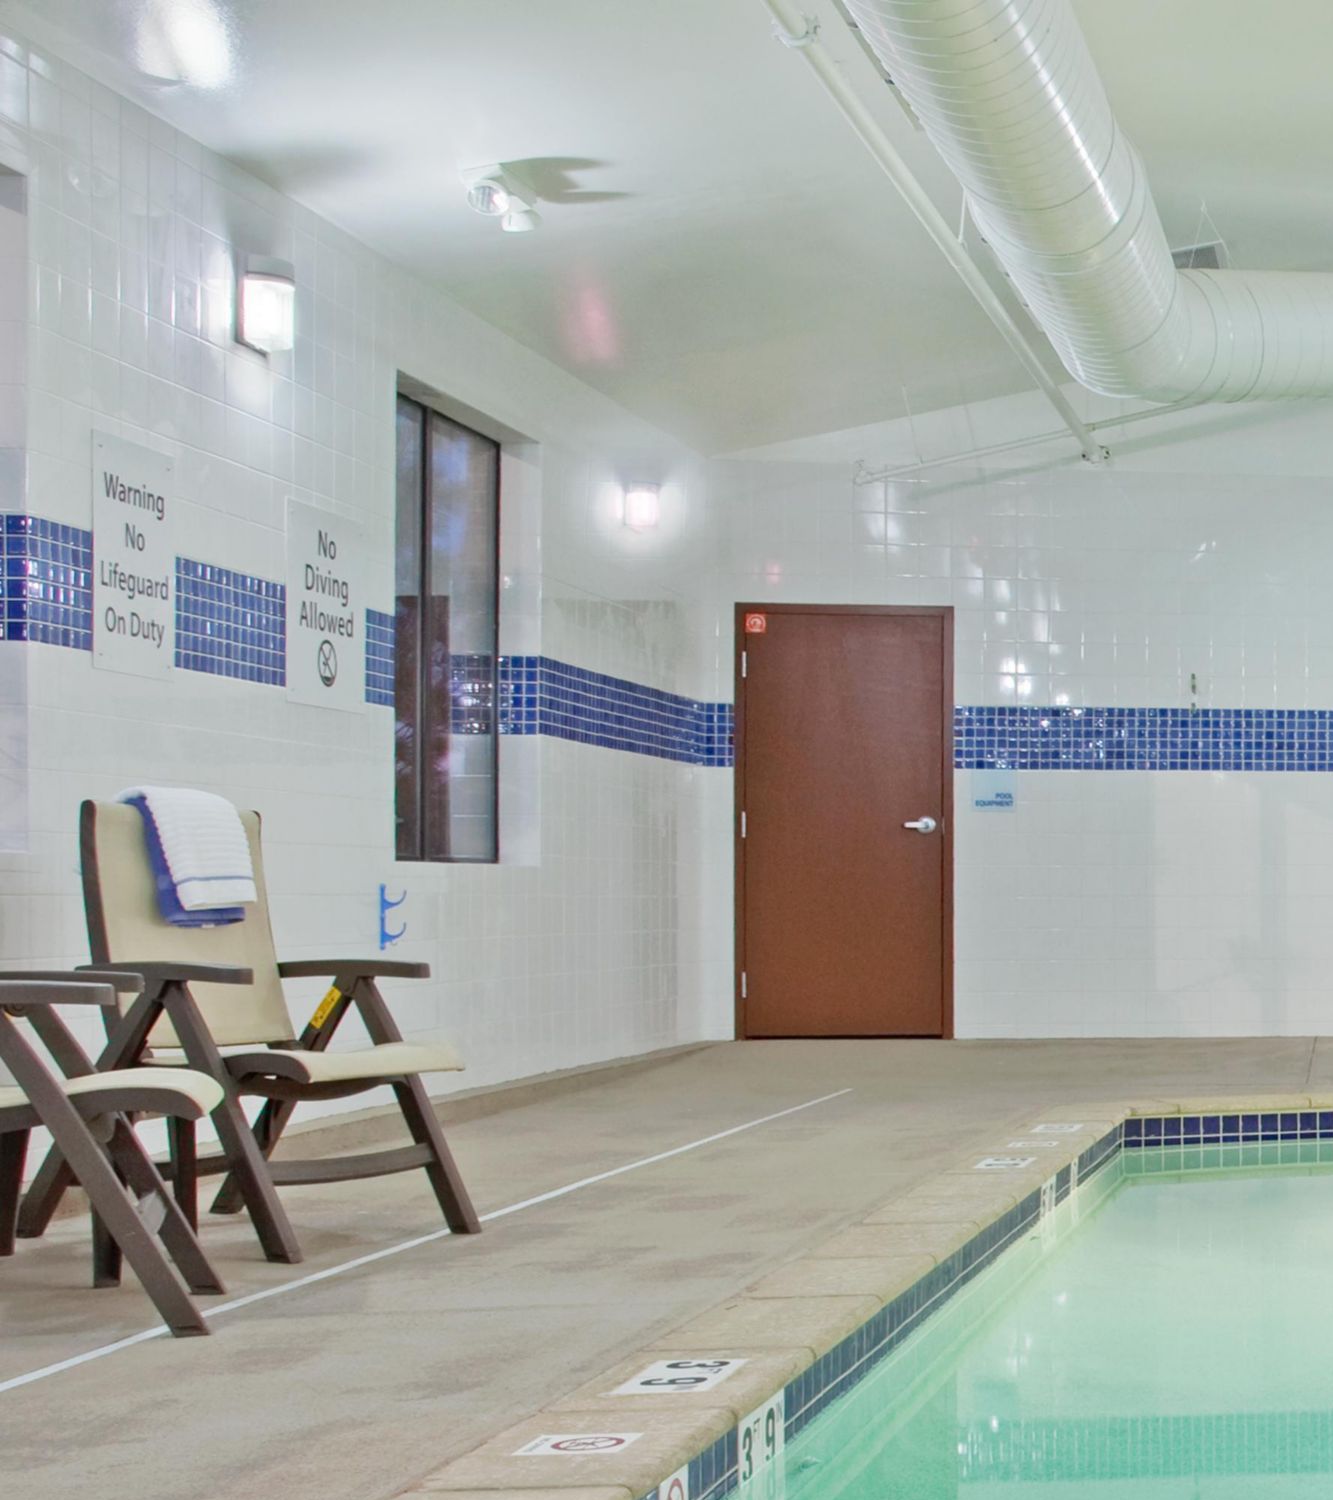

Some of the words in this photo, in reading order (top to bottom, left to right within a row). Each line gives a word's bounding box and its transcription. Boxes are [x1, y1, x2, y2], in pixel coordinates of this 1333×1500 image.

[103, 471, 165, 520] Warning
[125, 523, 145, 551] No
[318, 530, 337, 560] No
[100, 560, 169, 600] Lifeguard
[305, 564, 349, 607] Diving
[105, 607, 126, 635] On
[131, 612, 165, 648] Duty
[300, 601, 354, 638] Allowed
[742, 1427, 752, 1481] 3
[766, 1407, 775, 1461] 9
